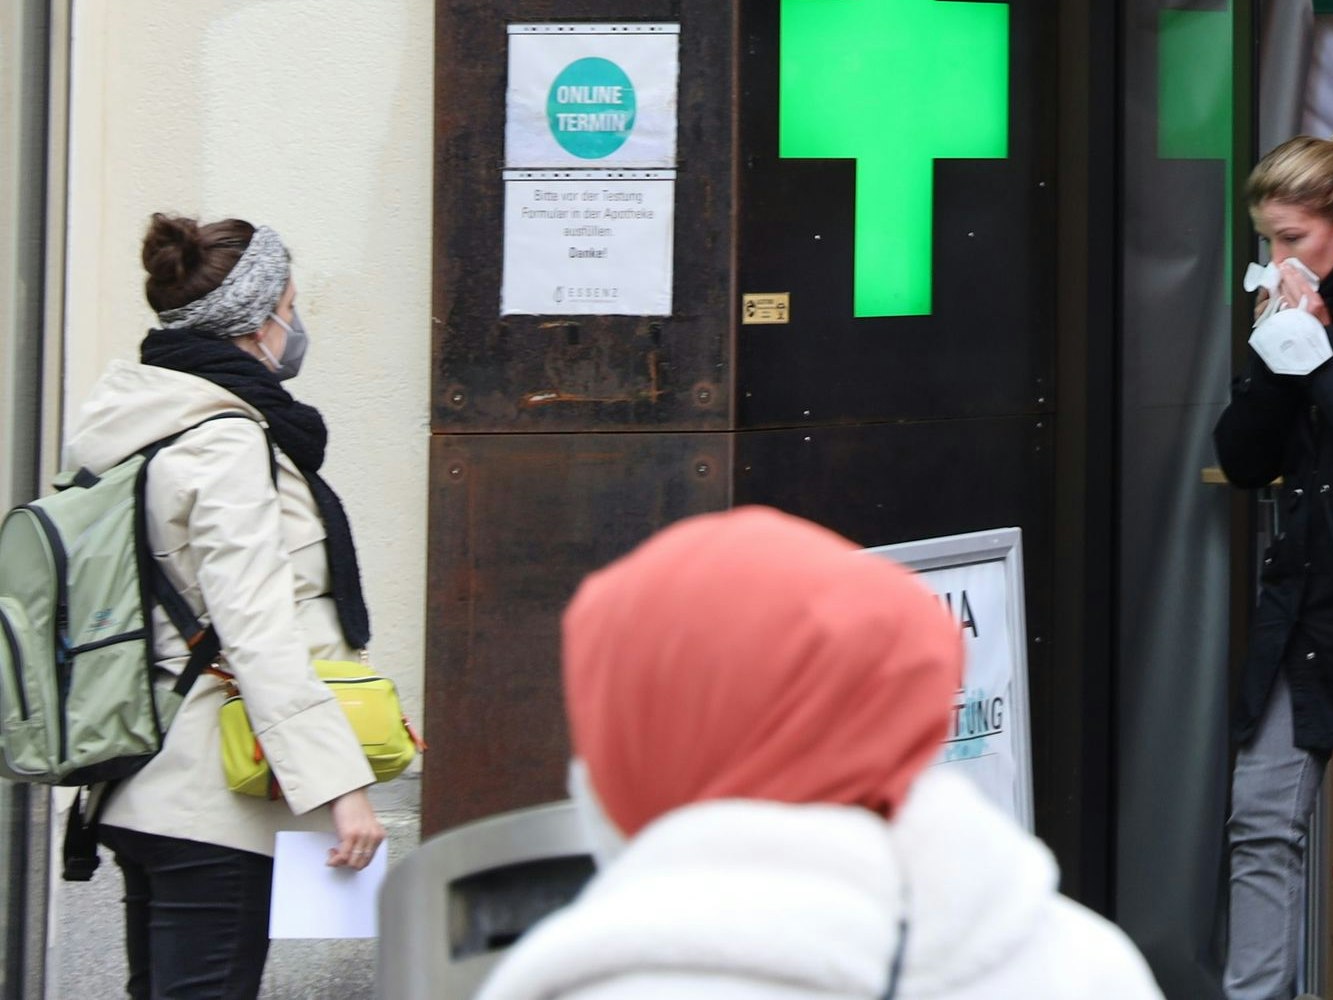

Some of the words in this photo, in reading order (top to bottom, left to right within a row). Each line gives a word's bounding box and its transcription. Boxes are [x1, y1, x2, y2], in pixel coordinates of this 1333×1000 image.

[555, 85, 623, 105] ONLINE
[556, 112, 629, 132] TERMIN
[951, 696, 1004, 737] TUNG
